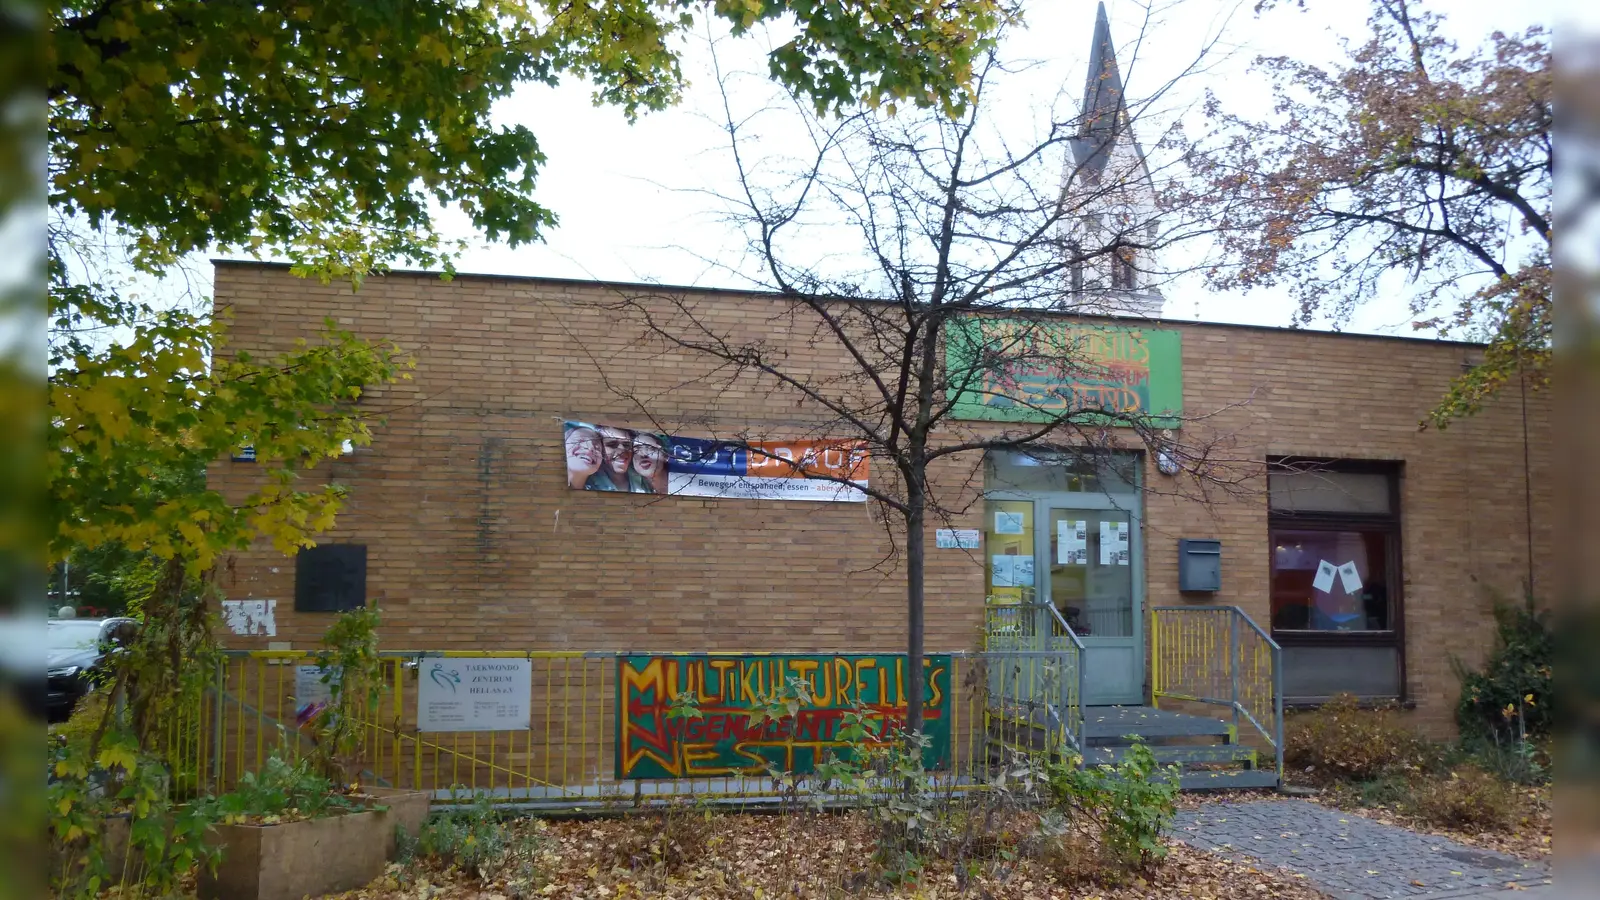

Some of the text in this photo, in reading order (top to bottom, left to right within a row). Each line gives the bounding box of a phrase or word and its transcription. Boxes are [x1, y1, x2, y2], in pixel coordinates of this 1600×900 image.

[698, 479, 737, 490] Bewegen,
[465, 664, 519, 672] TAEKWONDO
[472, 675, 512, 683] ZENTRUM
